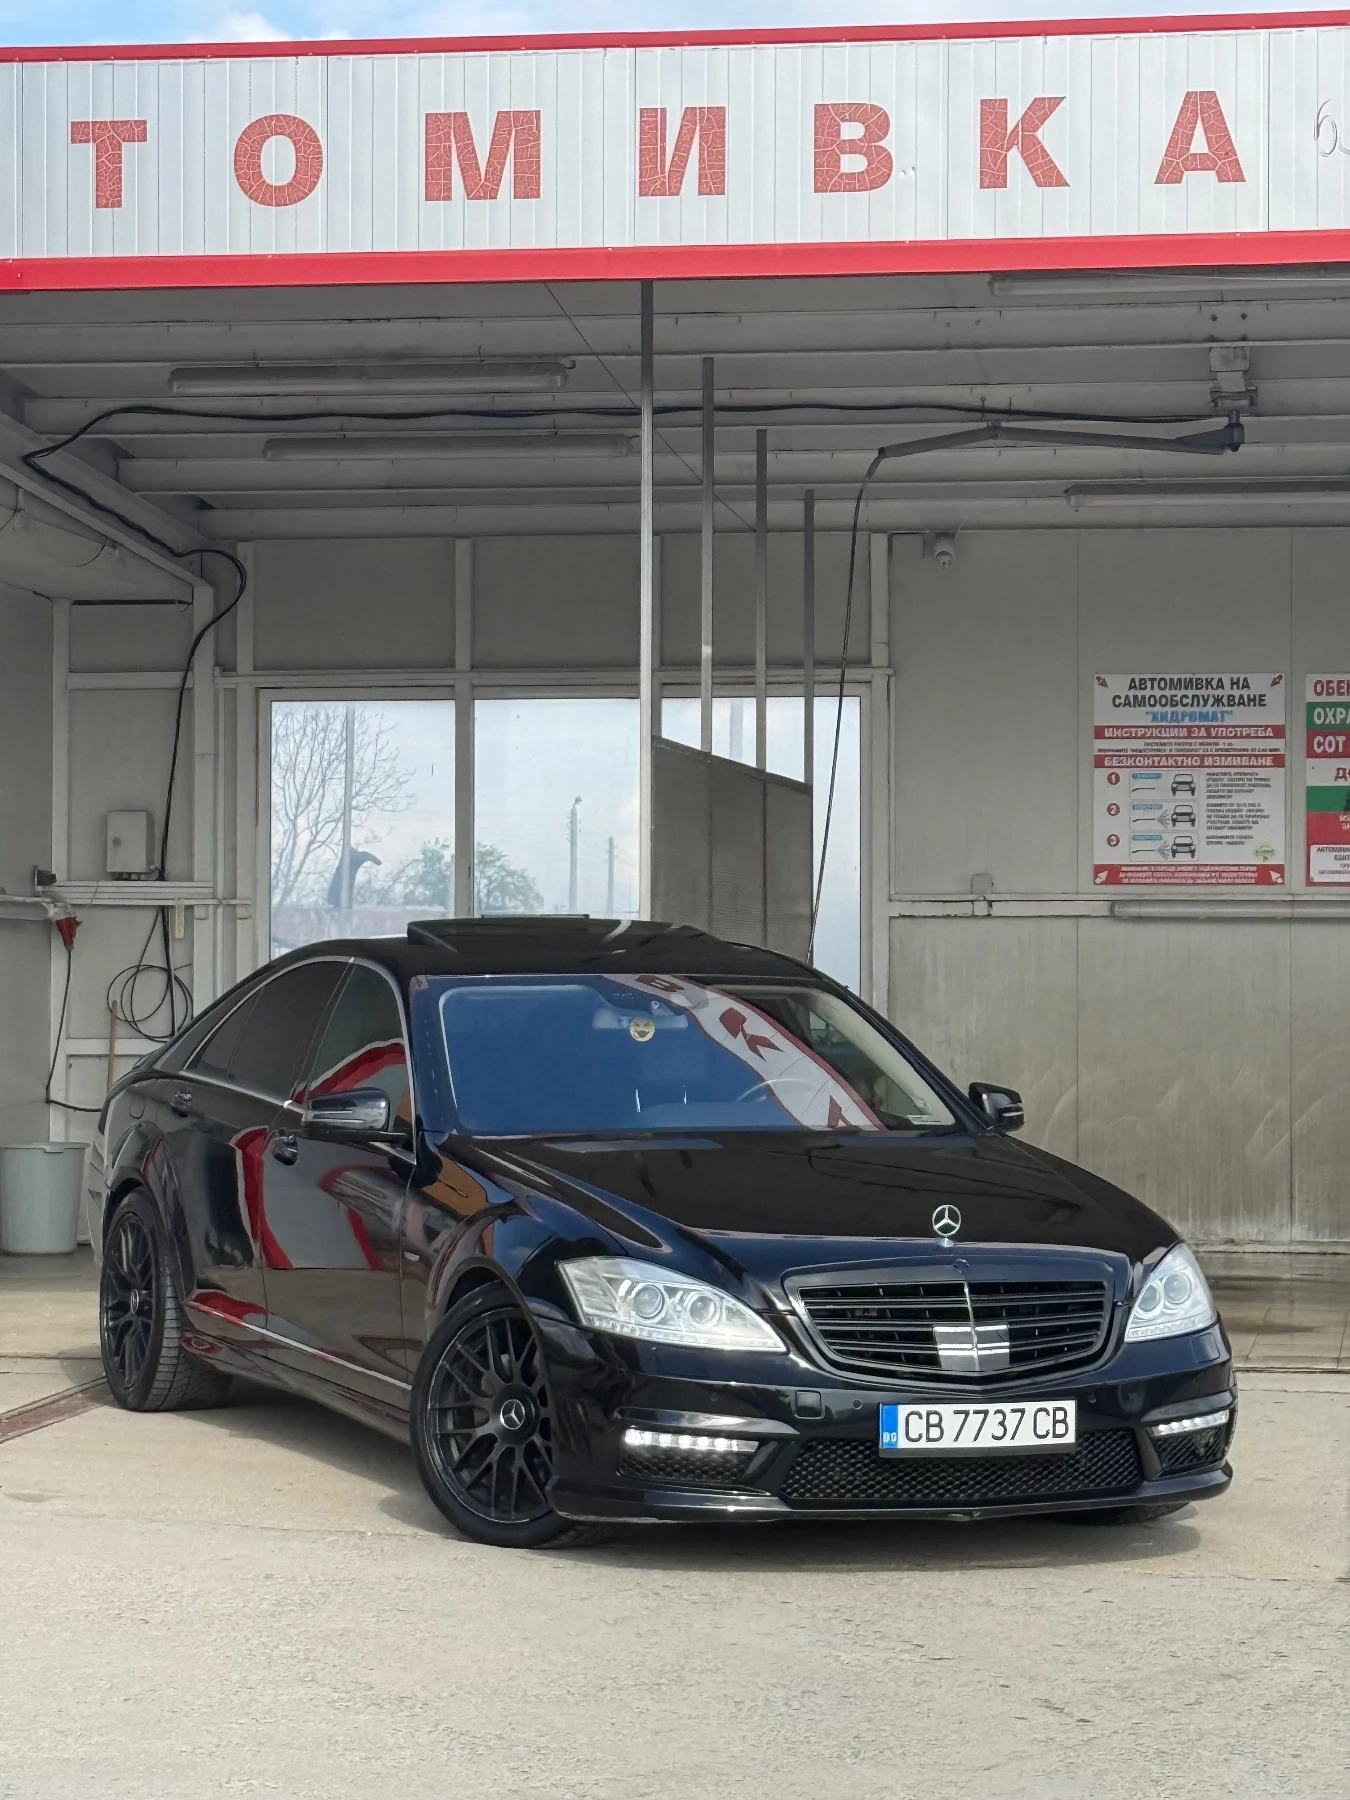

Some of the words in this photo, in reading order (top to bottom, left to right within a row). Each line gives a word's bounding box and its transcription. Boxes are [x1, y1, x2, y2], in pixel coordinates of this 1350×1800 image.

[1127, 676, 1225, 691] АВТОМИВКА
[1230, 676, 1251, 691] НА
[1313, 679, 1350, 697] ОБЕ
[1111, 693, 1267, 708] САМООБСЛУЖВАНЕ
[1104, 727, 1188, 738] ИНСТРУКЦИИ
[1190, 727, 1208, 737] ЗА
[1211, 726, 1274, 737] УПОТРЕБА
[1313, 735, 1347, 754] СОТ
[1104, 756, 1201, 767] БЕЗКОНТАКТНО
[1203, 756, 1275, 767] ИЗМИВАНЕ
[904, 1409, 945, 1443] CB
[953, 1407, 1026, 1442] 7737
[1033, 1406, 1069, 1440] CB
